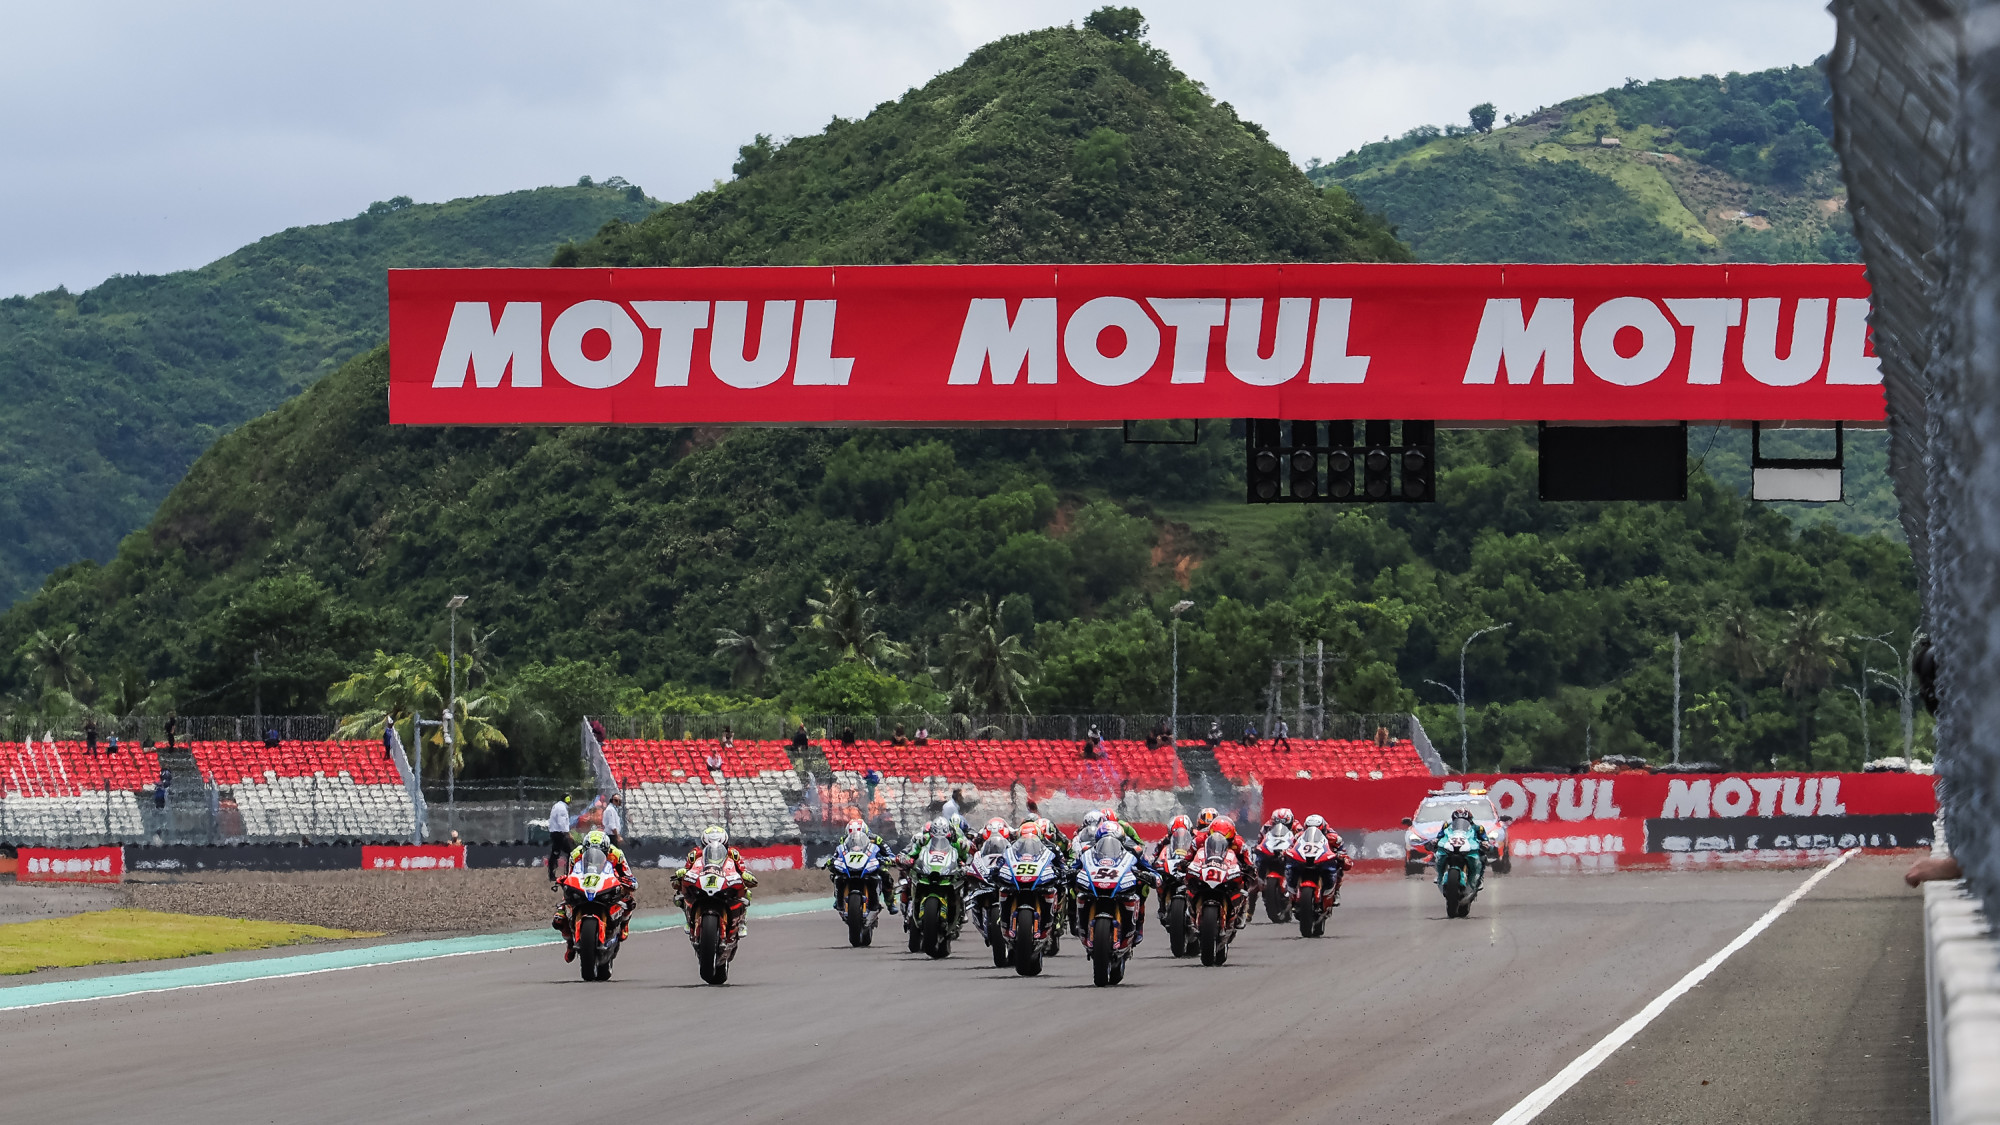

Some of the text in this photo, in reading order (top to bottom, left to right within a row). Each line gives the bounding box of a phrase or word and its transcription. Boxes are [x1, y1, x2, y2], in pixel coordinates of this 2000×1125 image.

[432, 299, 856, 390] MOTUL
[947, 297, 1371, 387] MOTUL
[1462, 297, 1884, 387] MOTUL
[1442, 779, 1622, 821] OTUL
[1660, 777, 1847, 818] MOTUL
[849, 854, 864, 863] 77
[1303, 844, 1320, 853] 97
[1016, 863, 1038, 875] 55
[1094, 868, 1119, 879] 54
[1205, 868, 1222, 882] 21
